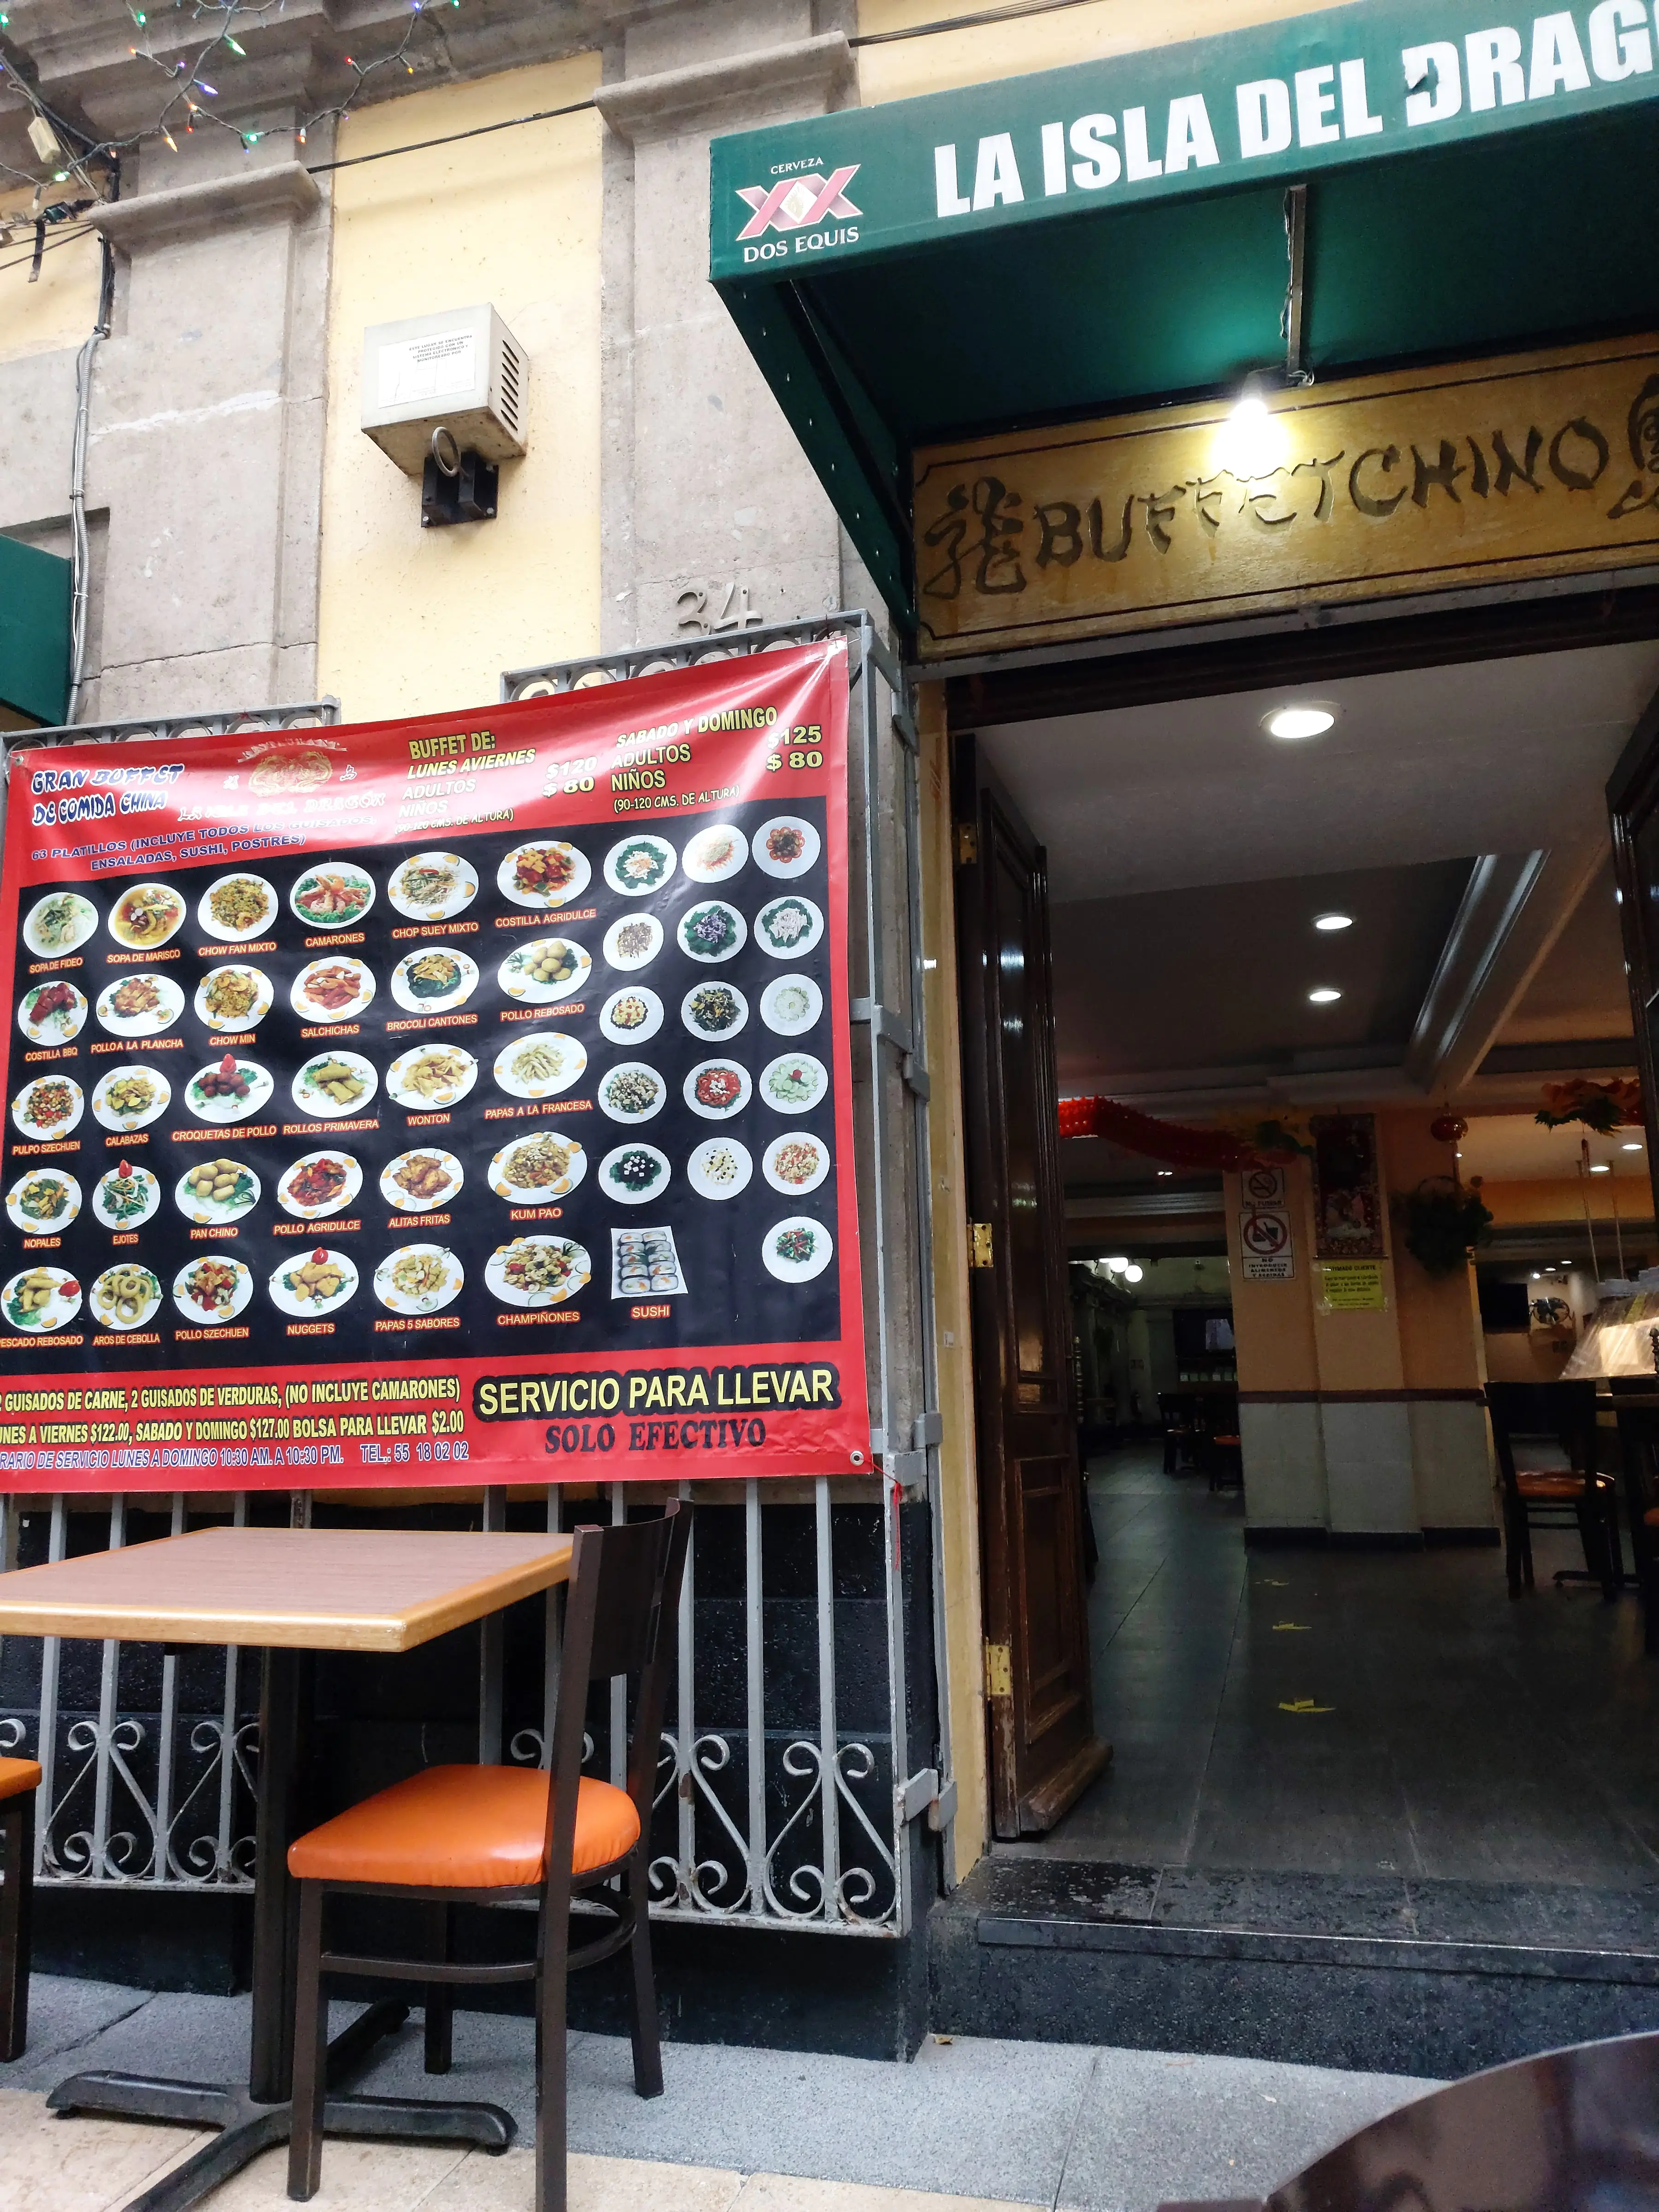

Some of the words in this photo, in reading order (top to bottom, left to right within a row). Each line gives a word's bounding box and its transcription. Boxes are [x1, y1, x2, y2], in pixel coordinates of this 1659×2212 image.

[935, 132, 1024, 218] LA
[1041, 94, 1220, 196] ISLA
[1236, 58, 1383, 159] DEL
[1402, 0, 1659, 127] DRAG
[771, 157, 824, 175] CERVEZA
[744, 240, 788, 263] DOS
[795, 226, 859, 253] EQUIS
[418, 345, 444, 353] PROTEGIDO
[433, 346, 465, 355] ELECTRONICO
[417, 353, 450, 362] MONITOREADO
[1348, 417, 1609, 518] CHINO
[678, 582, 763, 635] 34
[616, 722, 679, 748] SABADO
[684, 718, 694, 735] Y
[698, 706, 777, 734] DOMINGO
[409, 734, 467, 760] BUFFET
[471, 731, 496, 752] DE:
[611, 743, 691, 770] ADULTOS
[766, 725, 822, 750] $125
[401, 778, 477, 800] ADULTOS
[545, 756, 597, 780] $120
[407, 760, 459, 780] LUNES
[30, 770, 88, 794] GRAN
[611, 770, 666, 792] NIÑOS
[614, 797, 652, 813] (90-120
[654, 795, 679, 808] CMS.
[682, 792, 696, 805] DE
[698, 785, 740, 803] ALTURA)
[32, 802, 56, 826] DE
[58, 792, 117, 823] COMIDA
[119, 791, 168, 812] CHINA
[399, 800, 448, 818] NIÑOS
[456, 815, 468, 826] DE
[471, 808, 514, 823] ALTURA)
[51, 840, 127, 859] PLATILLOS
[129, 830, 195, 853] (INCLUYE
[198, 824, 249, 838] TODOS
[253, 822, 285, 832] LOS
[90, 850, 176, 871] ENSALADAS,
[179, 843, 228, 859] SUSHI,
[231, 834, 306, 853] POSTRES)
[495, 915, 541, 927] COSTILLA
[543, 909, 597, 924] AGRIDULCE
[392, 926, 419, 938] CHOP
[421, 924, 447, 936] SUEY
[448, 922, 478, 935] MIXTO
[305, 932, 365, 947] CAMARONES
[107, 953, 131, 964] SOPA
[132, 953, 144, 962] DE
[146, 949, 181, 962] MARISCO
[198, 945, 227, 957] CHOW
[229, 944, 247, 954] FAN
[248, 942, 276, 953] MIXTO
[60, 958, 83, 969] FIDEO
[500, 1009, 533, 1021] POLLO
[534, 1004, 584, 1018] REBOSADO
[301, 1024, 360, 1037] SALCHICHAS
[387, 1018, 427, 1031] BROCOLI
[428, 1014, 478, 1028] CANTONES
[140, 1037, 183, 1049] PLANCHA
[209, 1035, 237, 1046] CHOW
[238, 1034, 256, 1044] MIN
[25, 1050, 60, 1062] COSTILLA
[63, 1047, 78, 1058] BBQ
[485, 1107, 514, 1119] PAPAS
[542, 1101, 592, 1114] FRANCESA
[283, 1122, 323, 1134] ROLLOS
[324, 1119, 378, 1132] PRIMAVERA
[408, 1114, 450, 1126] WONTON
[106, 1134, 149, 1147] CALABAZAS
[172, 1130, 230, 1142] CROQUETAS
[232, 1128, 246, 1138] DE
[247, 1126, 276, 1137] POLLO
[12, 1143, 41, 1155] PULPO
[41, 1141, 81, 1153] SZECHUEN
[388, 1217, 418, 1228] ALITAS
[421, 1214, 450, 1226] FRITAS
[510, 1208, 536, 1220] KUM
[539, 1207, 562, 1218] PAO
[190, 1228, 207, 1239] PAN
[209, 1226, 238, 1238] CHINO
[274, 1223, 304, 1234] POLLO
[307, 1220, 361, 1233] AGRIDULCE
[24, 1237, 61, 1248] NOPALES
[112, 1234, 138, 1245] EJOTES
[497, 1312, 580, 1325] CHAMPIÑONES
[631, 1306, 671, 1318] SUSHI
[287, 1323, 335, 1335] NUGGETS
[376, 1320, 406, 1331] PAPAS
[415, 1317, 459, 1330] SABORES
[37, 1335, 83, 1346] REBOSADO
[94, 1335, 114, 1345] AROS
[126, 1332, 160, 1344] CEBOLLA
[176, 1330, 202, 1340] POLLO
[203, 1327, 248, 1339] SZECHUEN
[5, 1392, 65, 1412] GUISADOS
[67, 1391, 82, 1410] DE
[84, 1389, 129, 1413] CARNE,
[141, 1387, 197, 1408] GUISADOS
[199, 1387, 214, 1406] DE
[218, 1384, 282, 1409] VERDURAS,
[285, 1383, 308, 1409] (NO
[312, 1381, 368, 1403] INCLUYE
[372, 1377, 460, 1403] CAMARONES)
[479, 1377, 621, 1415] SERVICIO
[629, 1373, 709, 1410] PARA
[718, 1369, 834, 1406] LLEVAR
[28, 1425, 37, 1444] A
[40, 1424, 88, 1443] VIERNES
[90, 1422, 132, 1446] $122.00,
[135, 1421, 182, 1441] SABADO
[195, 1419, 247, 1441] DOMINGO
[250, 1417, 289, 1441] $127.00
[293, 1417, 337, 1438] BOLSA
[340, 1416, 374, 1436] PARA
[377, 1413, 427, 1435] LLEVAR
[432, 1410, 464, 1436] $2.00
[545, 1419, 616, 1453] SOLO
[628, 1418, 766, 1451] EFECTIVO
[37, 1450, 55, 1469] DE
[55, 1450, 110, 1469] SERVICIO
[111, 1448, 150, 1468] LUNES
[151, 1448, 161, 1467] A
[162, 1447, 218, 1467] DOMINGO
[220, 1447, 248, 1467] 10:30
[250, 1446, 273, 1466] AM.
[274, 1446, 284, 1465] A
[286, 1445, 318, 1465] 10:30
[320, 1444, 344, 1464] PM.
[360, 1444, 391, 1464] TEL.:
[394, 1442, 409, 1462] 55
[416, 1442, 430, 1461] 18
[434, 1441, 450, 1461] 02
[453, 1441, 469, 1461] 02
